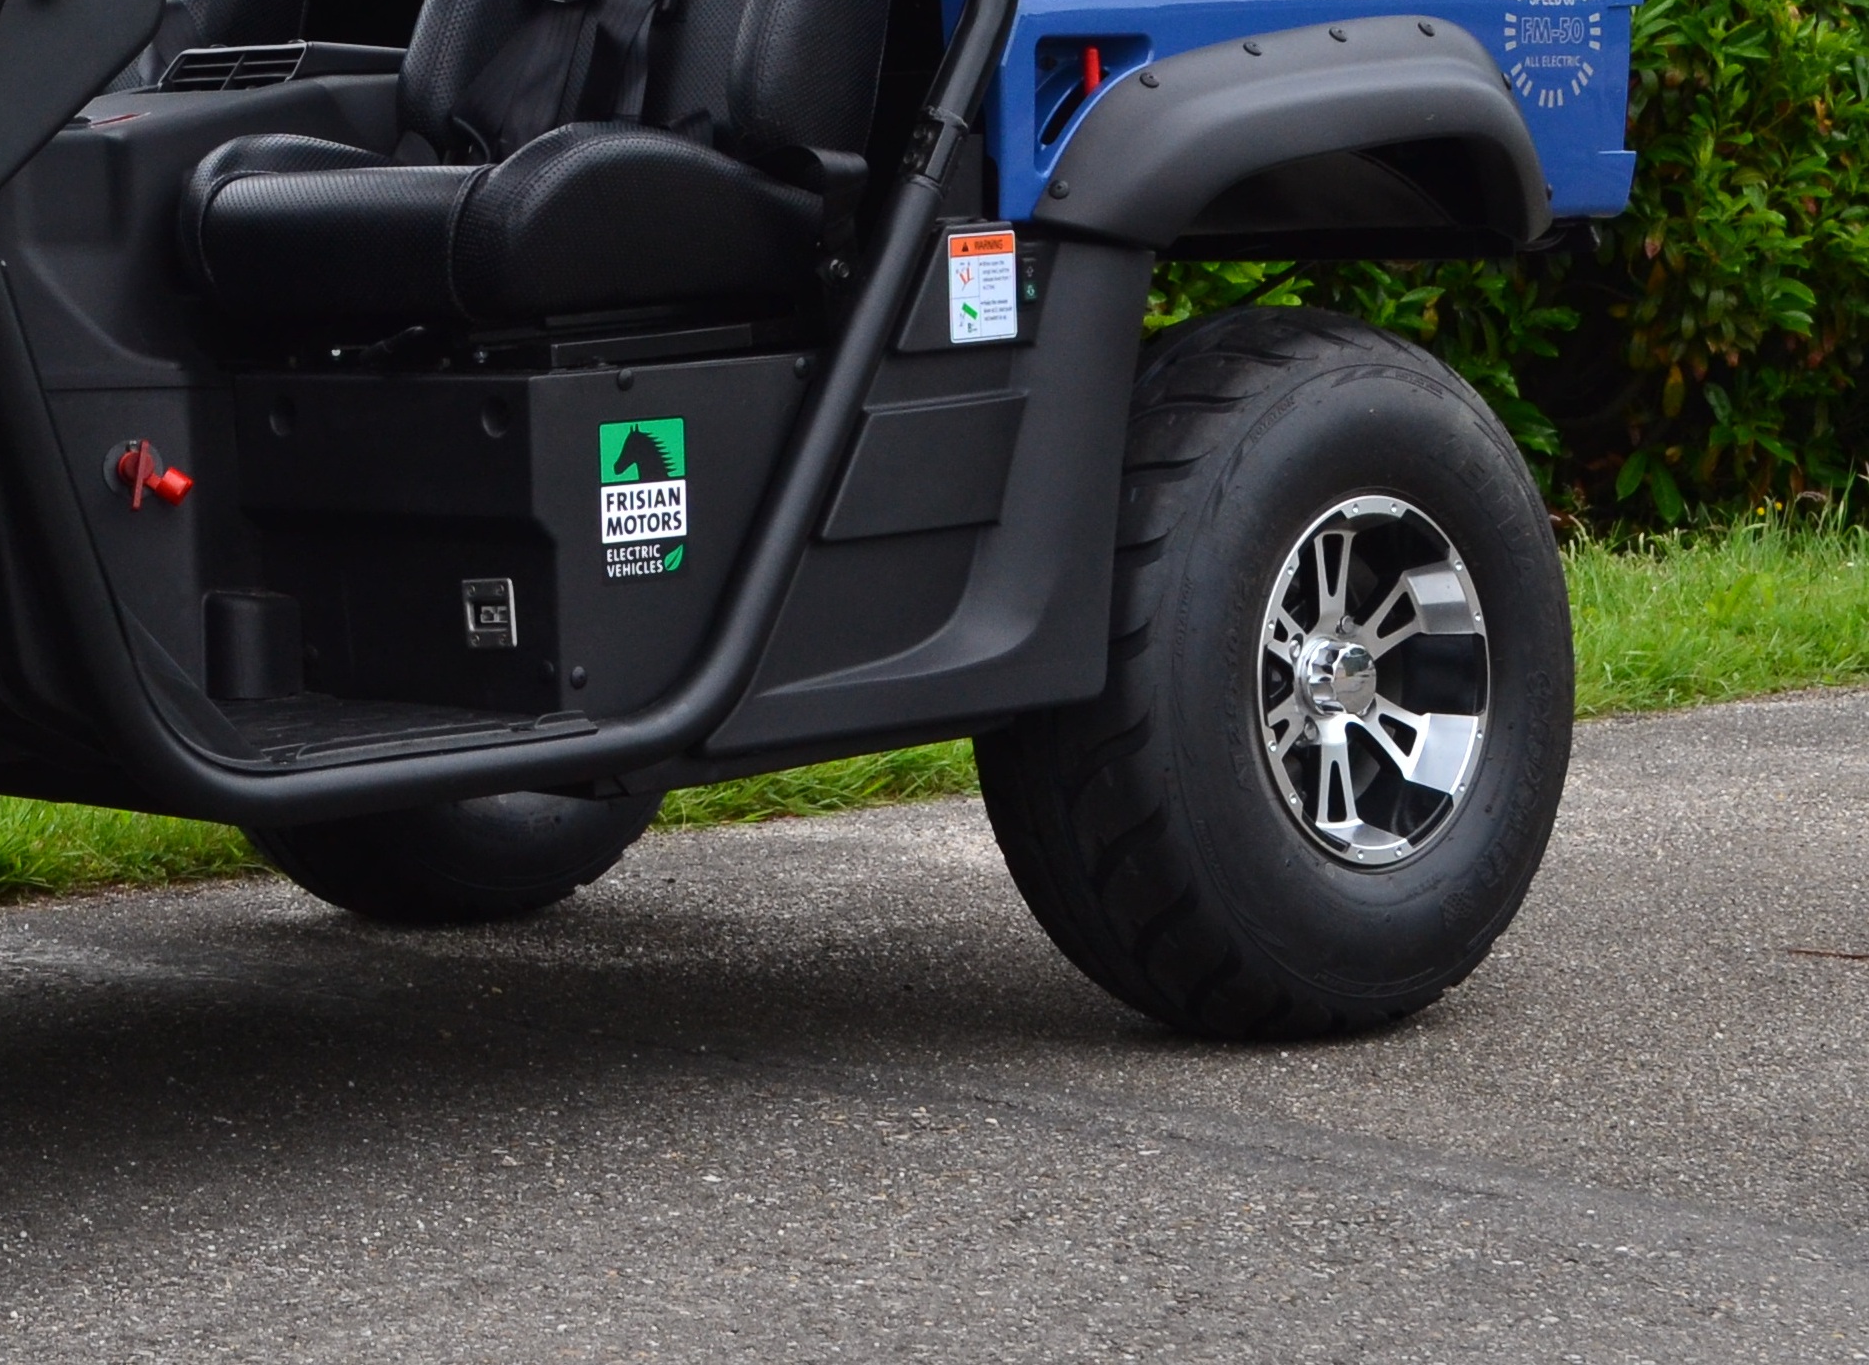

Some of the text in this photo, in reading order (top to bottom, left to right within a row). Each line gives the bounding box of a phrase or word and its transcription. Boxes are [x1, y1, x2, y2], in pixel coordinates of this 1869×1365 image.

[1521, 17, 1585, 44] FM-50
[1524, 55, 1581, 67] ALL ELECTRIC
[974, 239, 1004, 250] WARNING
[606, 486, 681, 513] FRISIAN
[606, 510, 682, 537] MOTORS
[607, 544, 661, 563] ELECTRIC
[607, 559, 664, 578] VEHICLES
